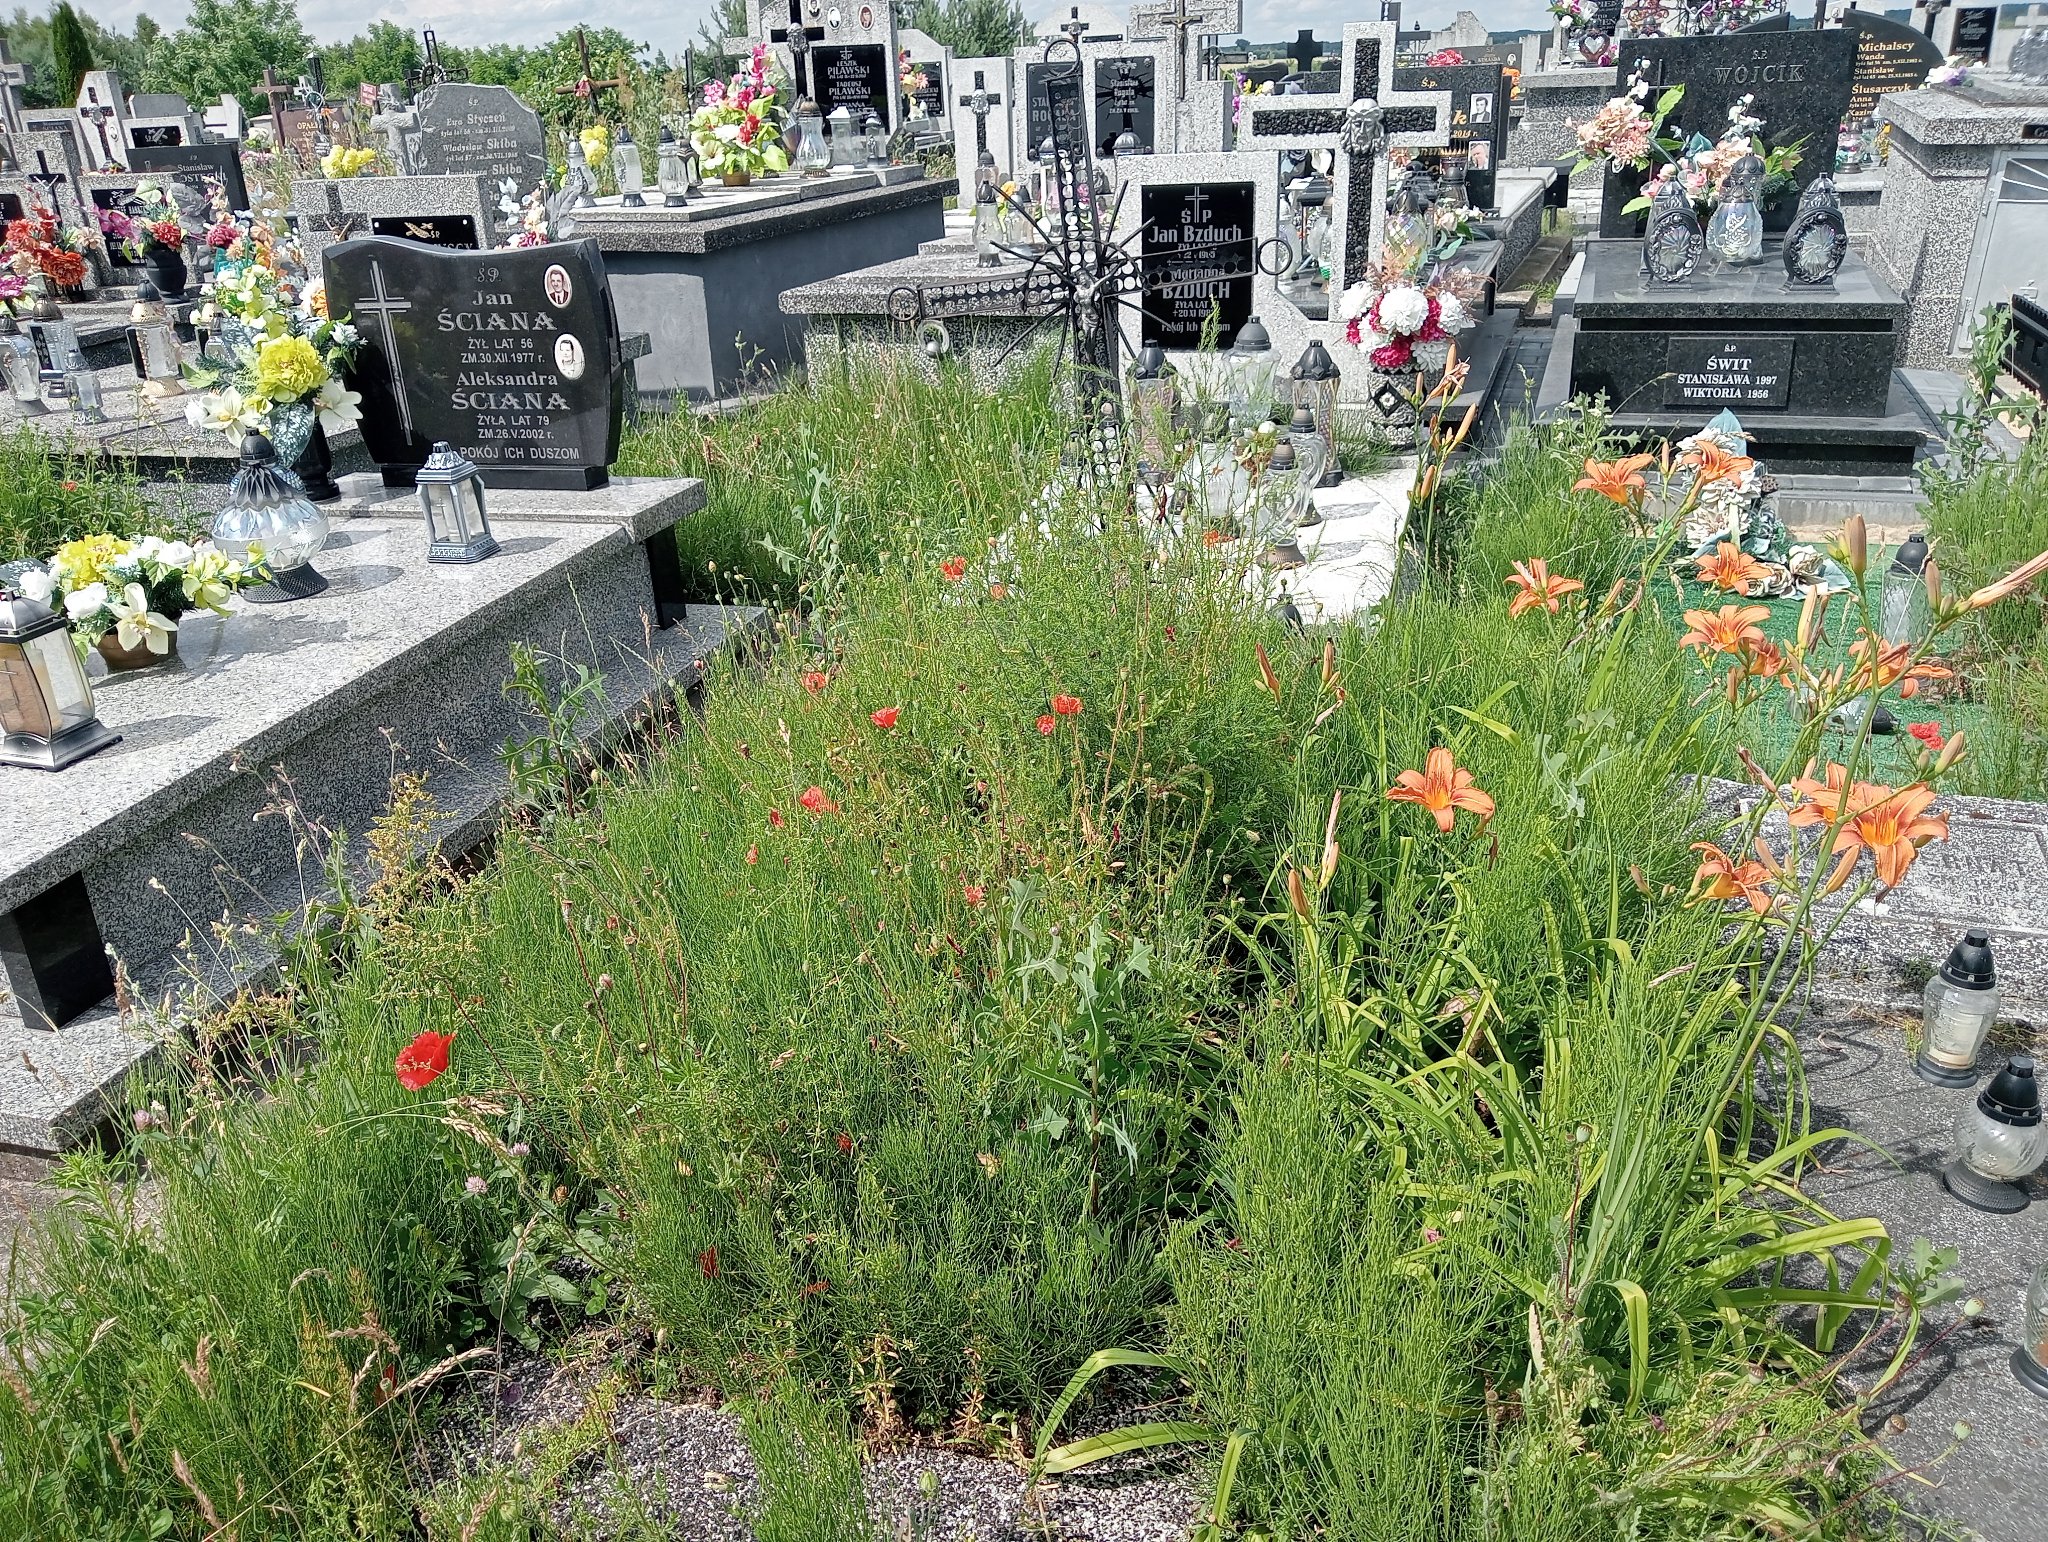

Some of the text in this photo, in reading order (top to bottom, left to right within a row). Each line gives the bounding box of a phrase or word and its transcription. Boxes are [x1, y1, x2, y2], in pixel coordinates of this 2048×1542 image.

[1858, 42, 1914, 52] Michalscy
[827, 66, 870, 75] PILAWSKI
[1714, 64, 1804, 84] WÓJCIK
[829, 87, 870, 95] PILAWSKI
[1852, 83, 1911, 94] Ślusarczyk
[467, 114, 505, 126] Styczeń
[487, 138, 517, 149] Skiba
[177, 163, 214, 171] Stanisław
[492, 163, 522, 174] Skiba
[1149, 224, 1242, 243] Jan Bzduch
[1162, 281, 1230, 299] BZDUCH
[472, 290, 513, 306] Jan
[438, 308, 557, 331] ŚCIANA
[468, 336, 533, 349] ŻYŁ LAT 56
[461, 353, 545, 363] ZM.30.XII.1977 r.
[1707, 355, 1751, 370] ŚWIT
[456, 371, 558, 386] Aleksandra
[1678, 374, 1777, 385] STANISŁAWA 1997
[451, 388, 570, 410] ŚCIANA
[1684, 388, 1768, 398] WIKTORIA 1956
[477, 413, 550, 426] ŻYŁA LAT 79
[478, 429, 554, 439] ZM.26.V.2002 r.
[460, 445, 580, 459] POKÓJ ICH DUSZOM
